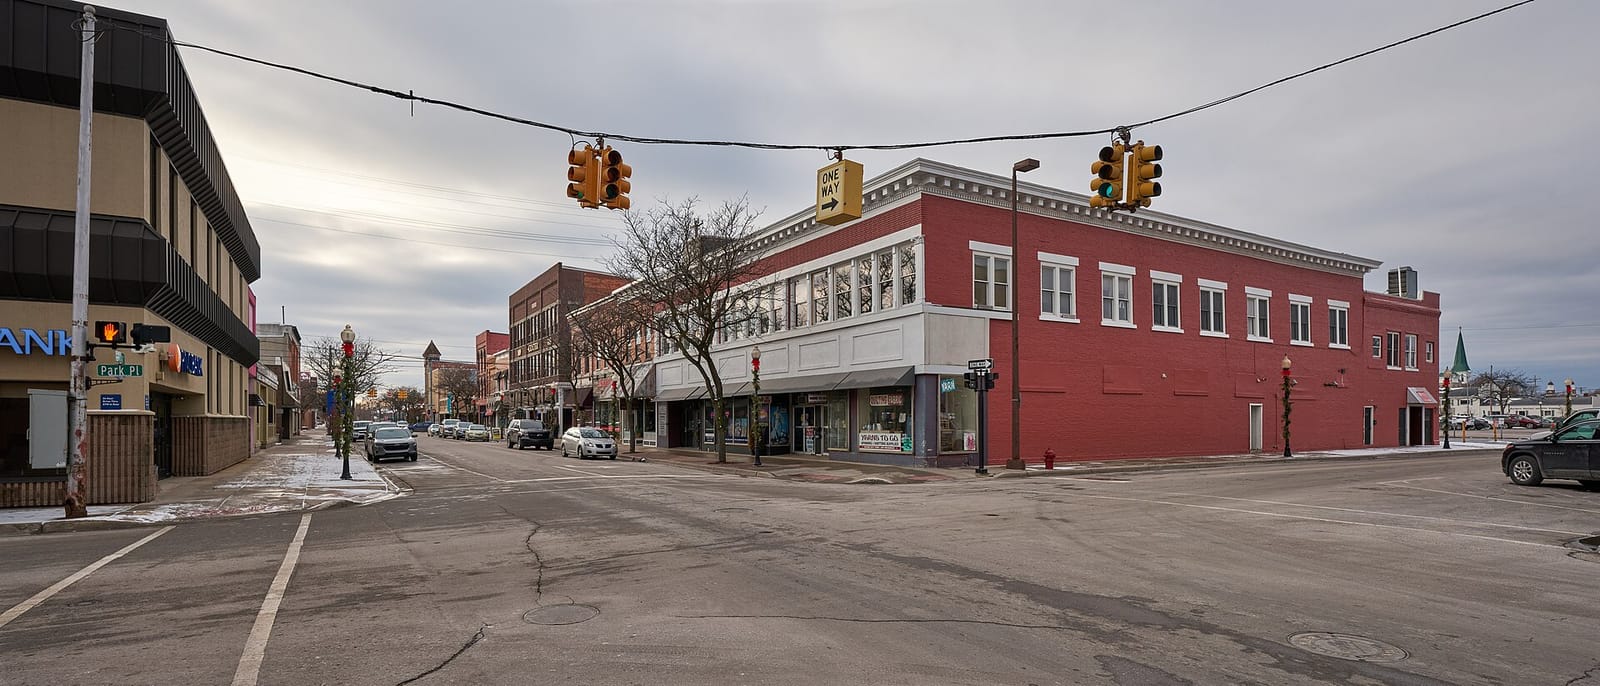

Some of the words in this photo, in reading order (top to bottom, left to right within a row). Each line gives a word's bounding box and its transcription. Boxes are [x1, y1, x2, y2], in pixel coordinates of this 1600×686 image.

[822, 169, 840, 185] ONE
[821, 181, 840, 198] WAY
[101, 365, 125, 377] Park
[130, 365, 140, 376] Pl
